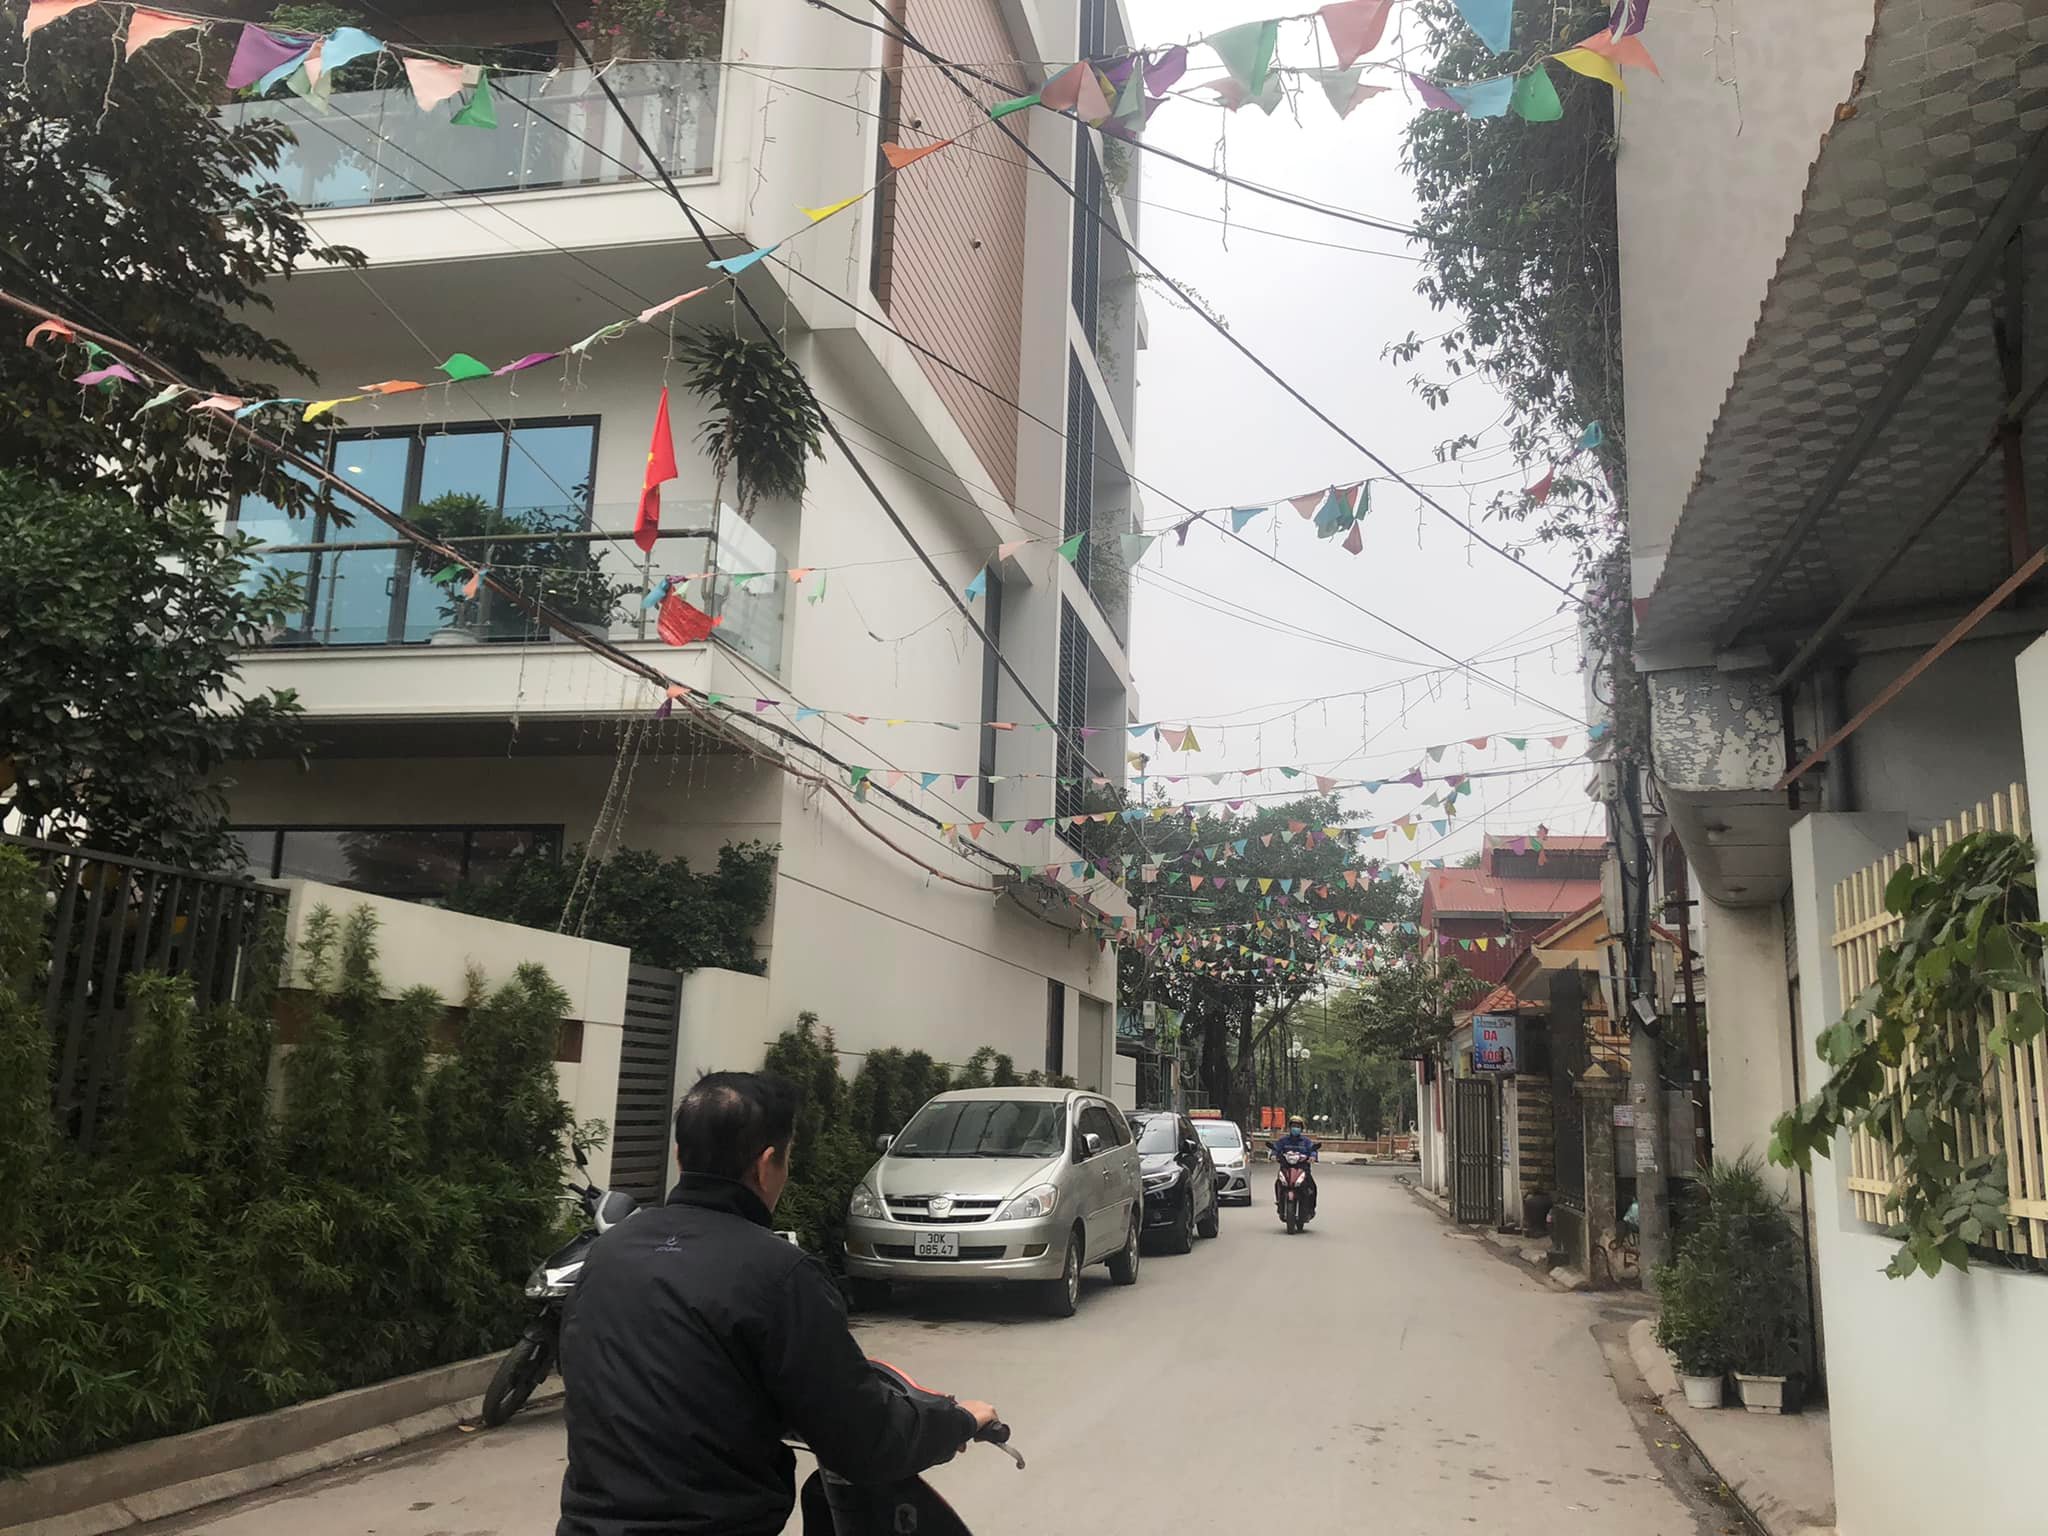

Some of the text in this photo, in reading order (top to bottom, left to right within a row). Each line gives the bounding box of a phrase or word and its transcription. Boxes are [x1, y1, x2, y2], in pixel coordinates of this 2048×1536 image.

[1483, 1029, 1498, 1041] DA
[927, 1233, 946, 1244] 30K
[919, 1244, 954, 1255] 085.47
